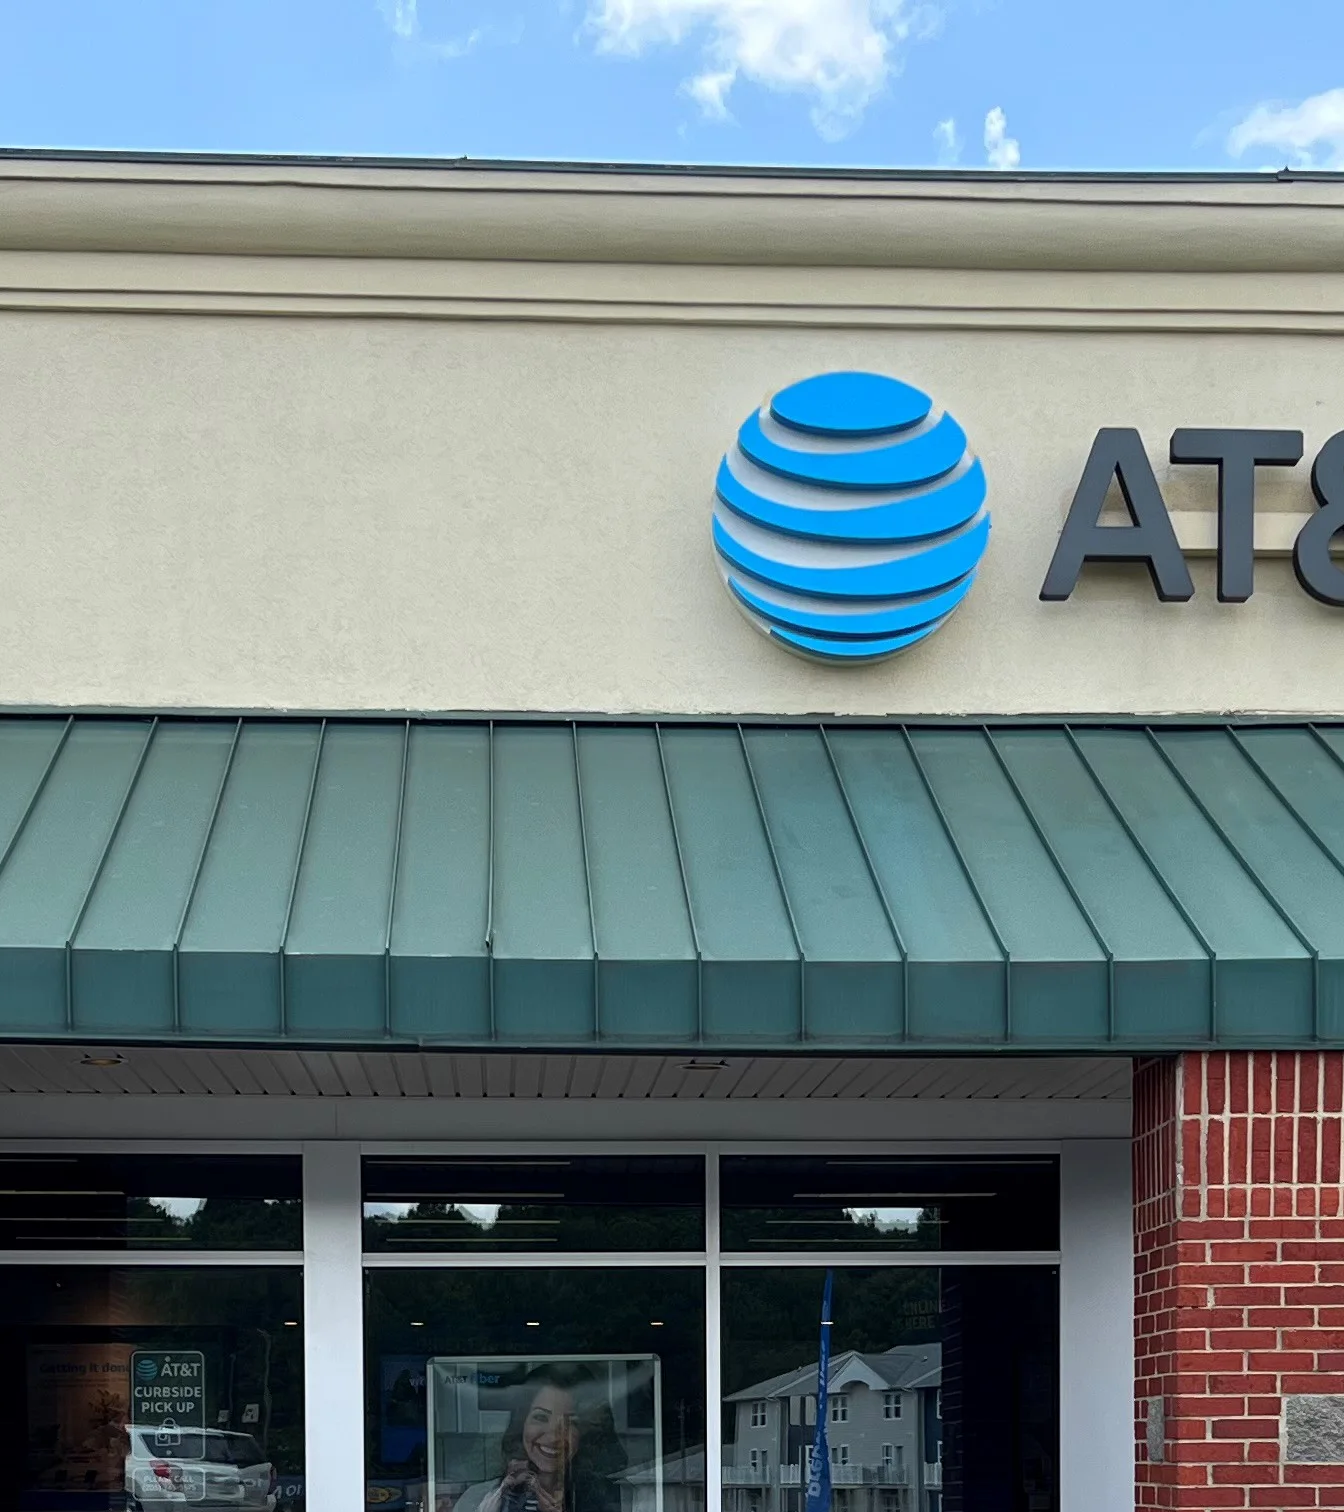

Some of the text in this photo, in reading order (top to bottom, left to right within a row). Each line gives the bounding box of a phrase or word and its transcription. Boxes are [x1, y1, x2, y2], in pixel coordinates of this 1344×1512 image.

[161, 1363, 201, 1377] AT&T
[134, 1386, 202, 1398] CURBSIDE
[141, 1401, 195, 1413] PICK UP
